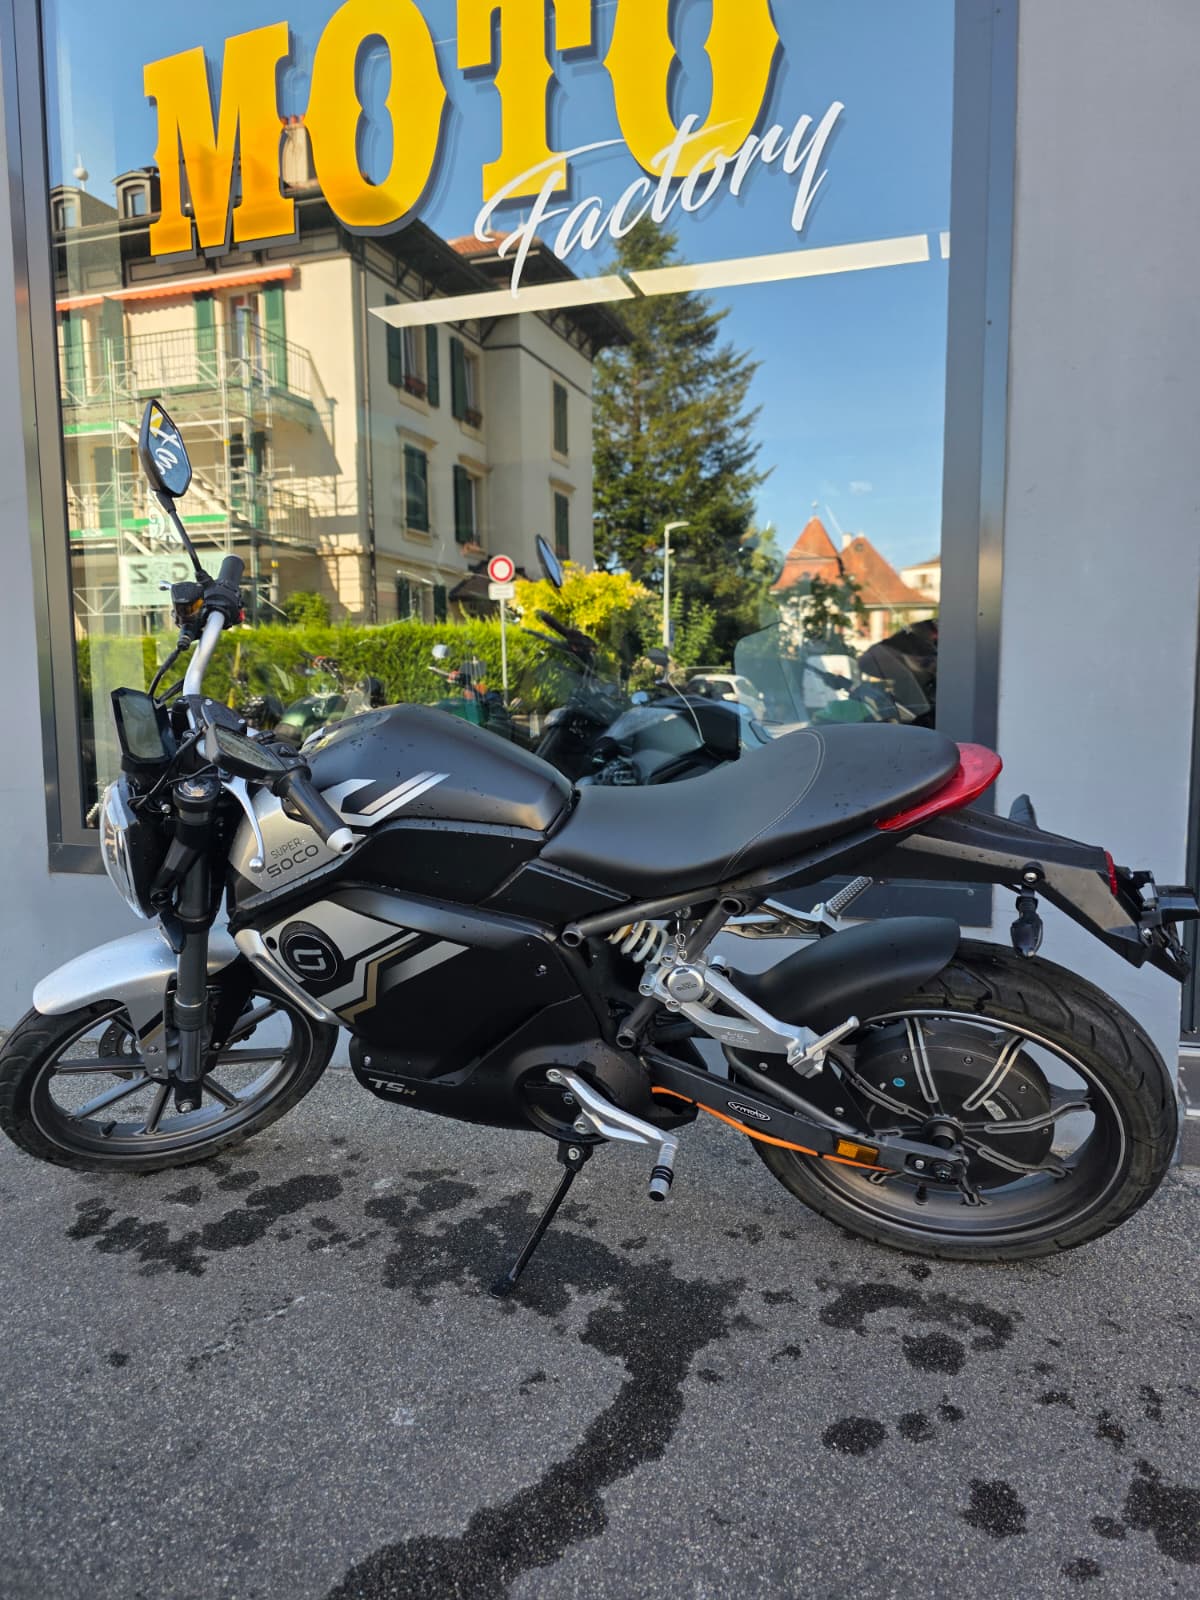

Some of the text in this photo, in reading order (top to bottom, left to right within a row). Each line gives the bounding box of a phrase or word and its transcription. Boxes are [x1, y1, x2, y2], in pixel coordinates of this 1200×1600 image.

[143, 0, 779, 257] MOTO
[474, 101, 844, 298] Factory
[266, 844, 319, 878] SOCO
[270, 837, 302, 859] SUPER
